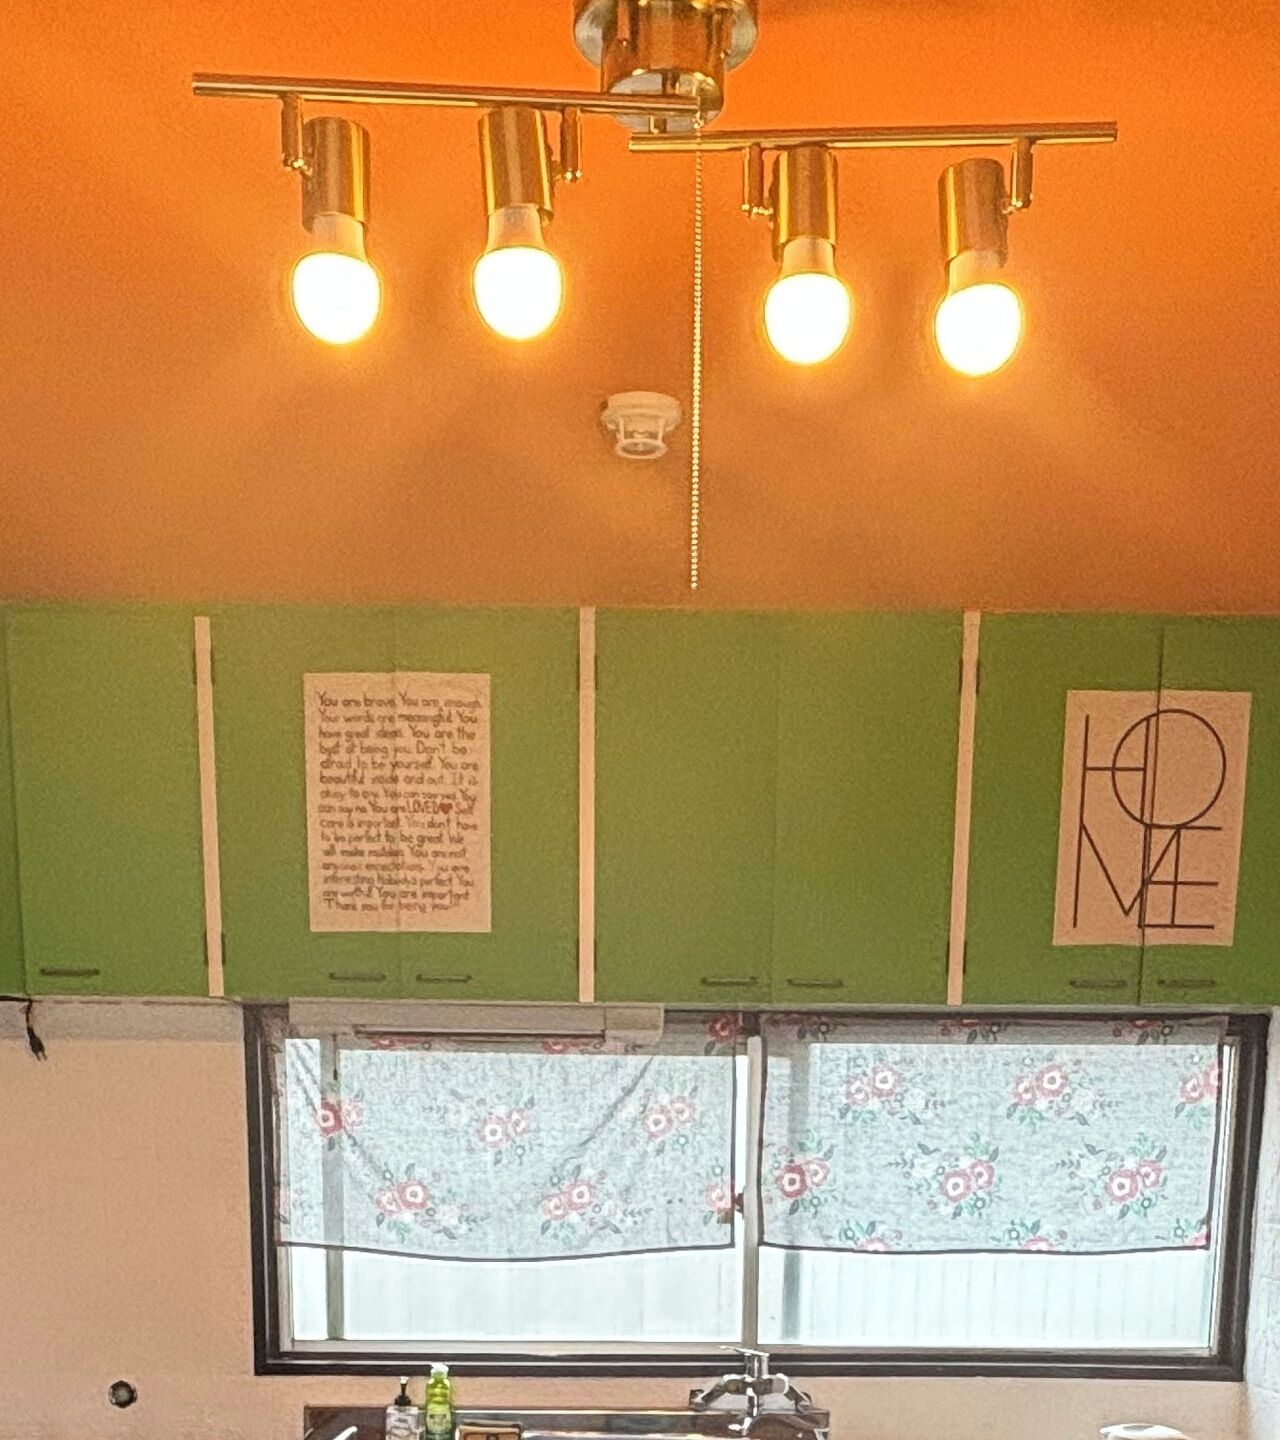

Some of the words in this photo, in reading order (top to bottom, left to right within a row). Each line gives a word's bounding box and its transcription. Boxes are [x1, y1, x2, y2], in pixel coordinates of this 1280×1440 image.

[316, 691, 338, 707] You
[399, 690, 419, 706] You
[457, 710, 478, 723] You
[408, 723, 430, 739] You
[457, 727, 476, 740] the
[452, 741, 467, 754] be
[372, 754, 386, 769] be
[438, 755, 457, 770] You
[461, 761, 478, 771] are
[400, 831, 414, 843] be
[407, 845, 428, 858] You
